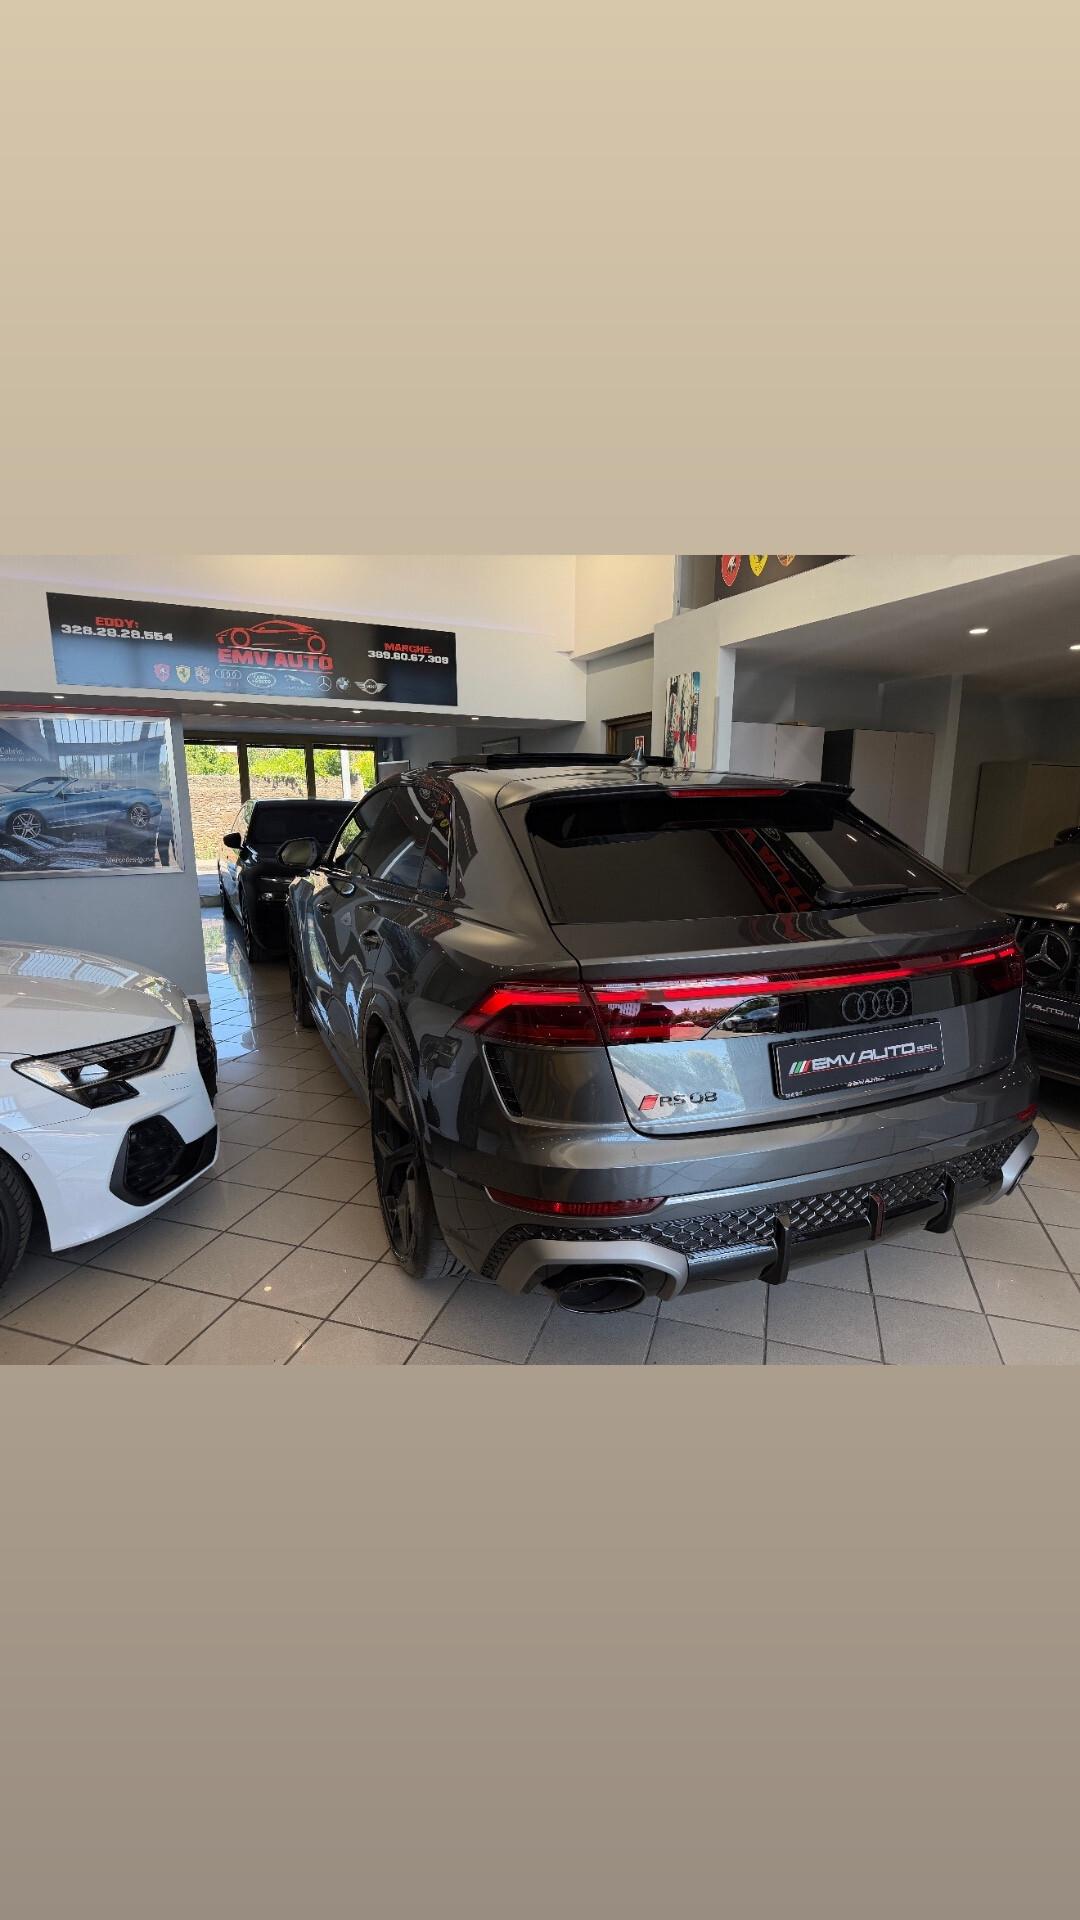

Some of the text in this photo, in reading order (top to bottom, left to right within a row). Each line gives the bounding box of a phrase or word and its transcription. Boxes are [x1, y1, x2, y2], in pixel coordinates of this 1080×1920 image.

[95, 616, 139, 629] EDDY:
[217, 648, 334, 670] EMV AUTO
[811, 1052, 856, 1072] EMV
[857, 1042, 916, 1064] AUTO
[659, 1094, 687, 1107] RS
